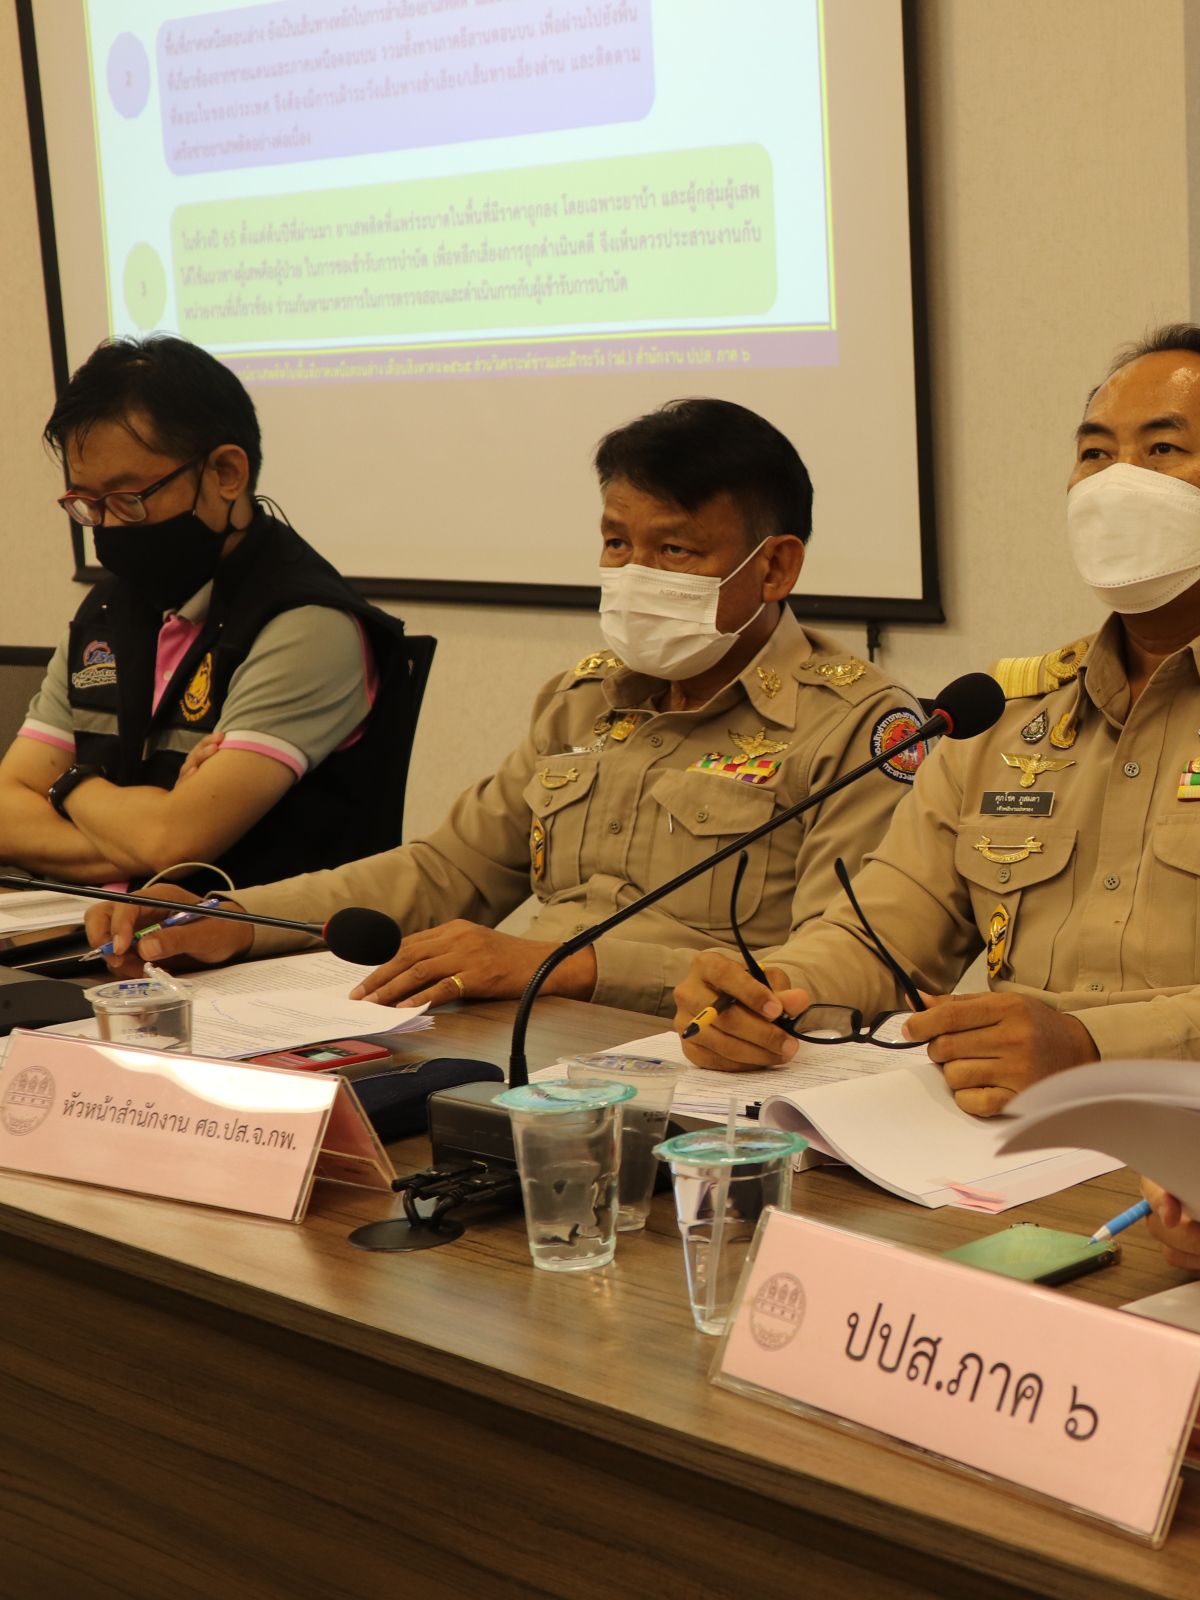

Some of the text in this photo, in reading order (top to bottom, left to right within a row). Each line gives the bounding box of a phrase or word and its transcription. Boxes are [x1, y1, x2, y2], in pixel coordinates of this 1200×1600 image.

[62, 1091, 191, 1134] หัวหน้าสำนักงาน
[194, 1117, 297, 1151] ศอ.ปส.จ.กพ.
[844, 1302, 1044, 1425] ปปส.ภาค
[1064, 1384, 1100, 1442] ๖
